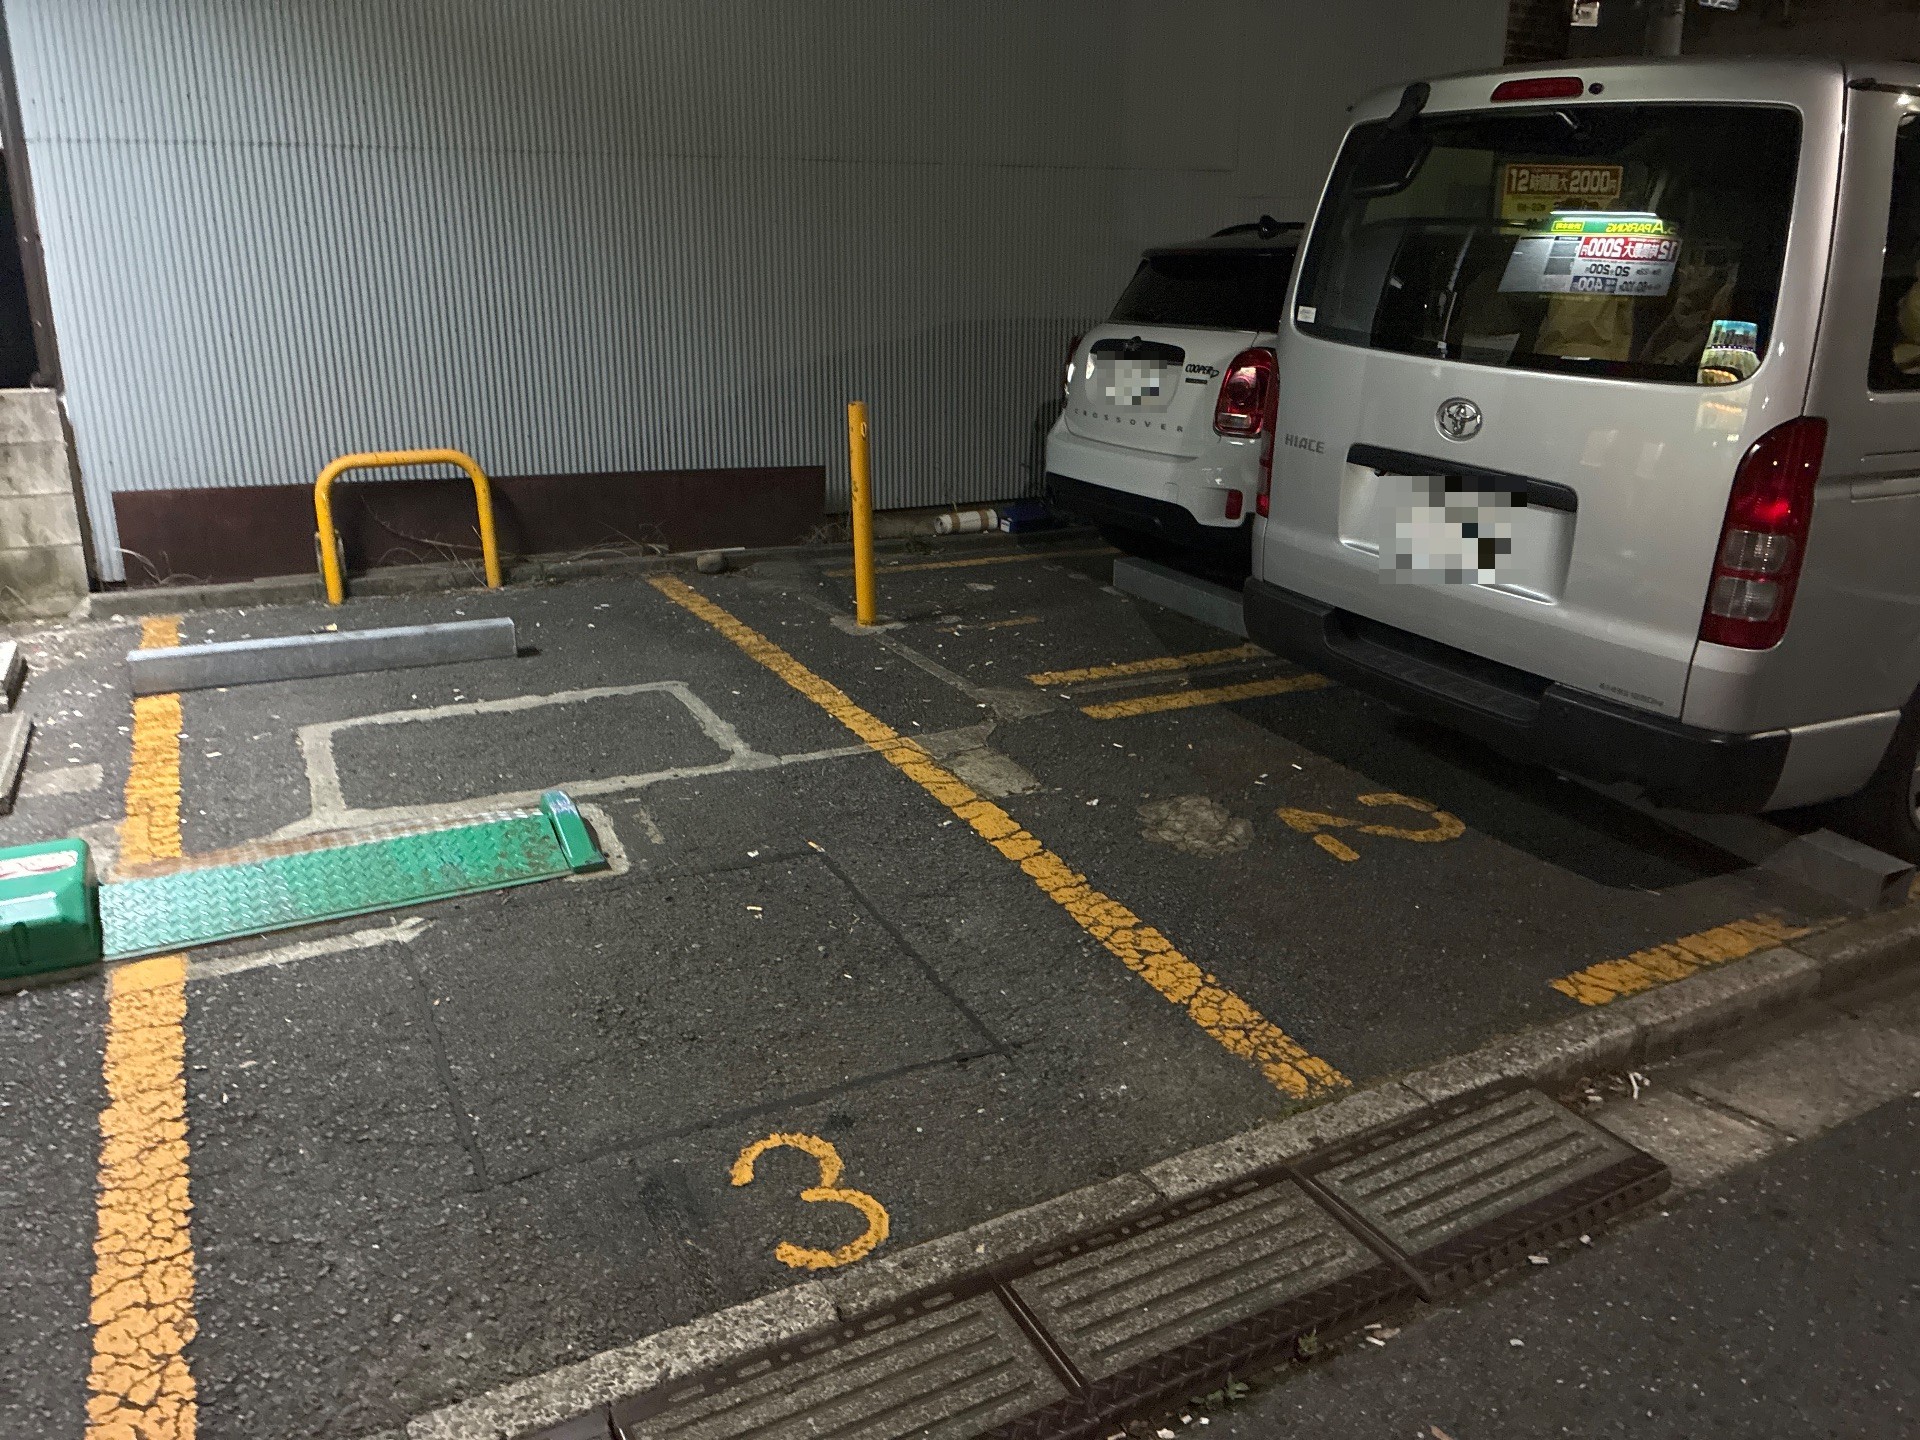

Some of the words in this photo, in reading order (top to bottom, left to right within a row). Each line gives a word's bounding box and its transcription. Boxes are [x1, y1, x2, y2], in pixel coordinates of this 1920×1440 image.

[1284, 433, 1325, 454] HIACE
[1276, 792, 1466, 862] 2
[729, 1132, 890, 1271] 3
